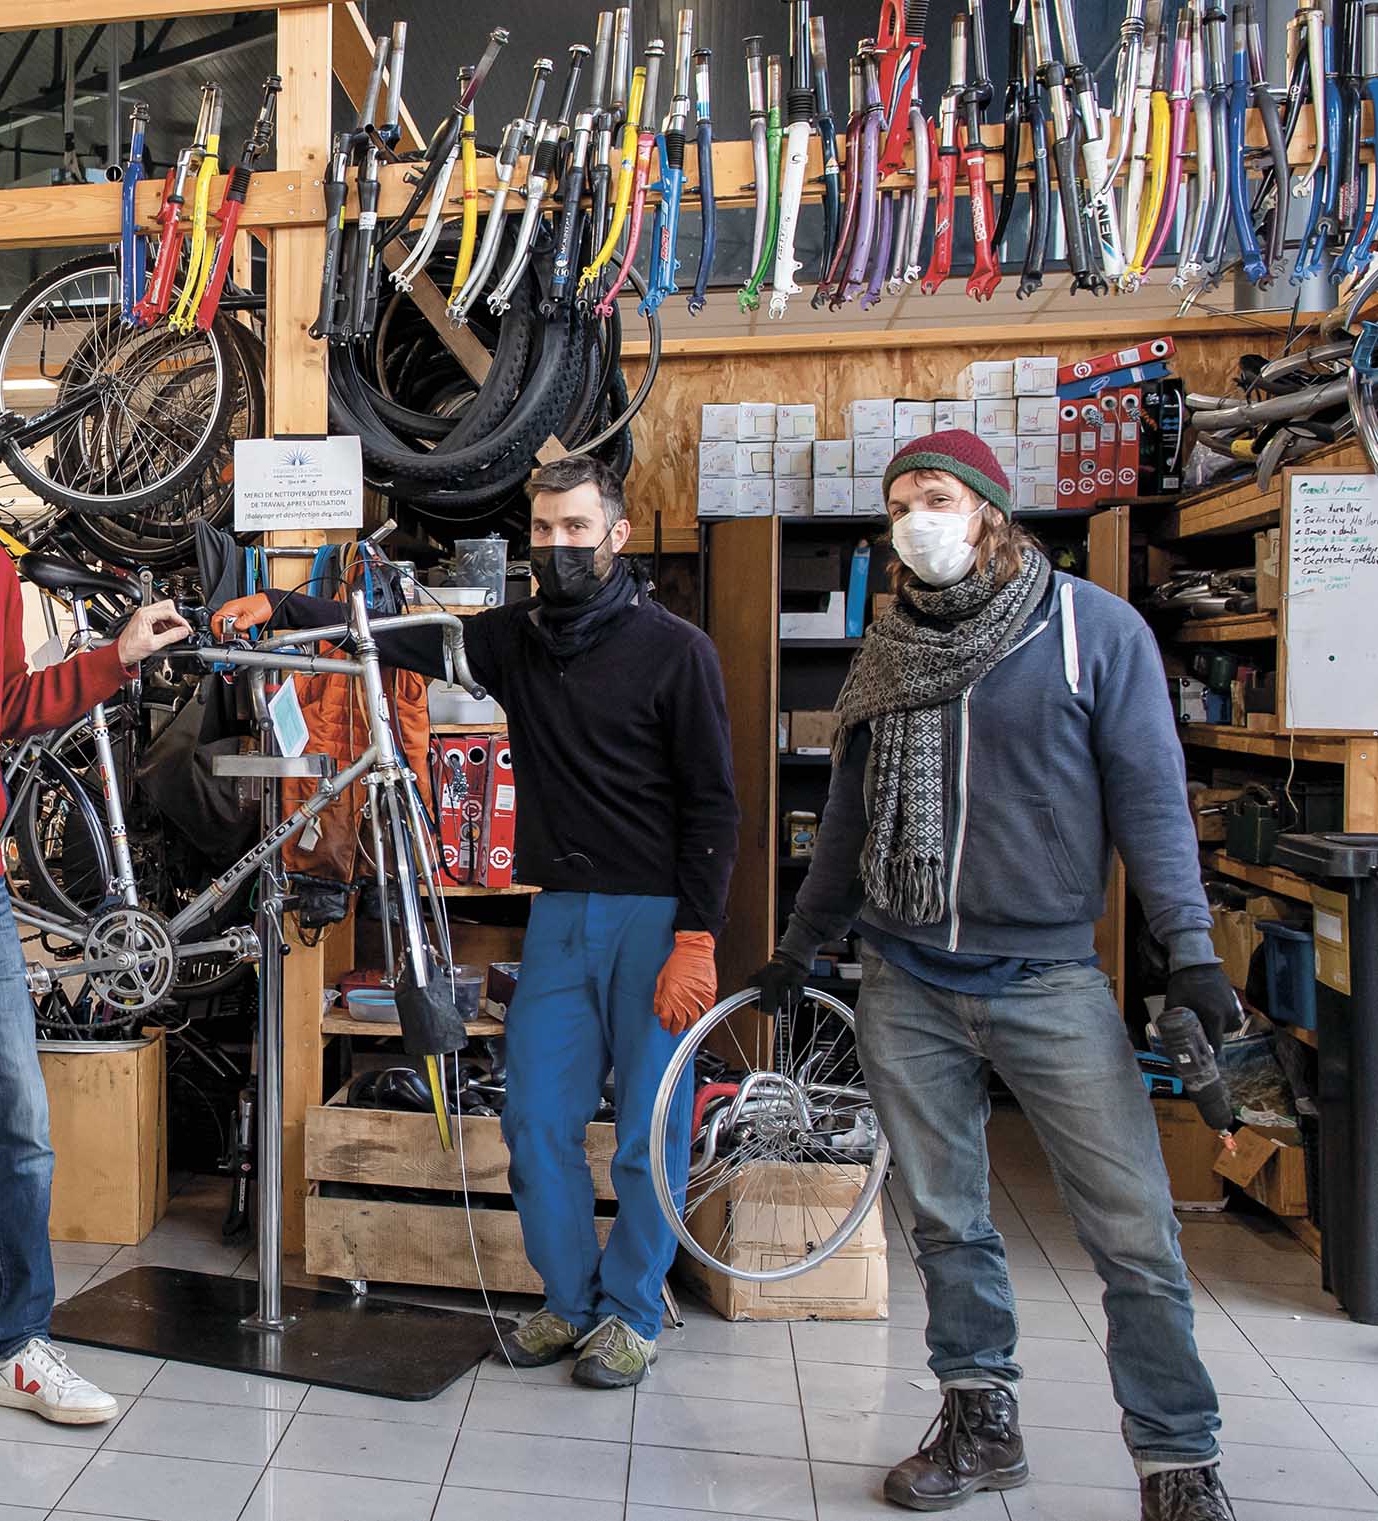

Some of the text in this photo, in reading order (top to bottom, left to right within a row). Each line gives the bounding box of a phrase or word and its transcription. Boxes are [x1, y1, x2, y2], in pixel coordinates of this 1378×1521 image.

[244, 491, 264, 499] MERCI
[274, 490, 306, 498] NETTOYER
[329, 489, 353, 497] ESPACE
[250, 501, 259, 509] DE
[307, 499, 346, 507] UTILISATION
[222, 818, 296, 883] PEUGEOT
